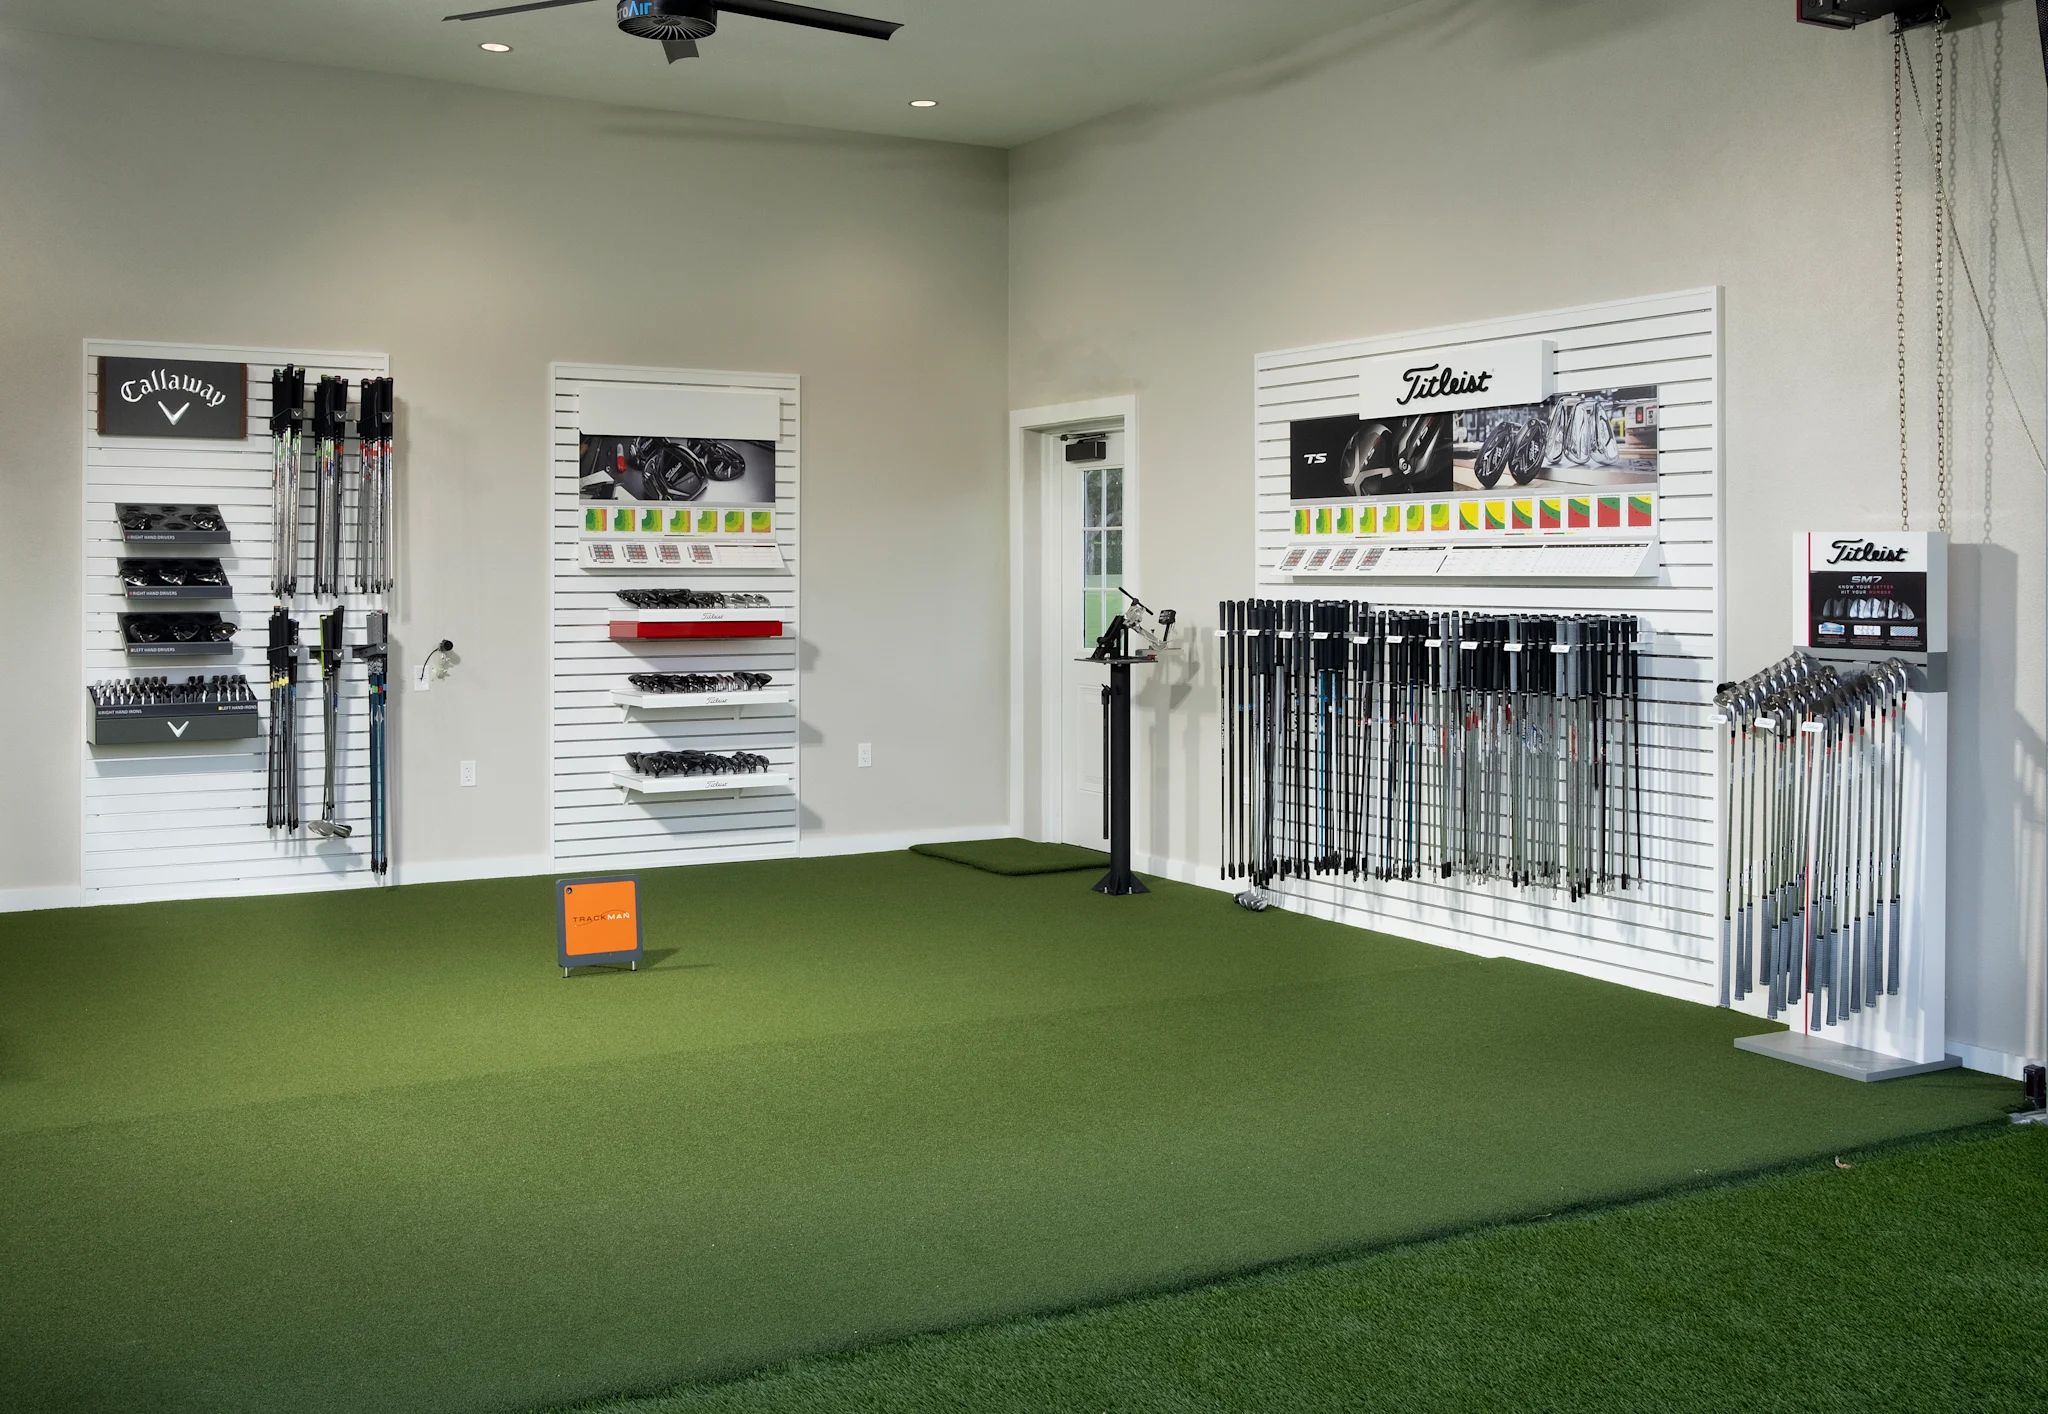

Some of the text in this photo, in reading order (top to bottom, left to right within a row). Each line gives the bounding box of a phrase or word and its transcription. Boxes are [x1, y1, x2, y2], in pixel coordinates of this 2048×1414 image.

[121, 368, 226, 407] Callaway
[1396, 363, 1493, 405] Titleist
[1303, 453, 1328, 465] TS
[1826, 538, 1909, 565] Titleist
[1851, 575, 1883, 584] SM7
[573, 912, 630, 922] TRACKMAN
